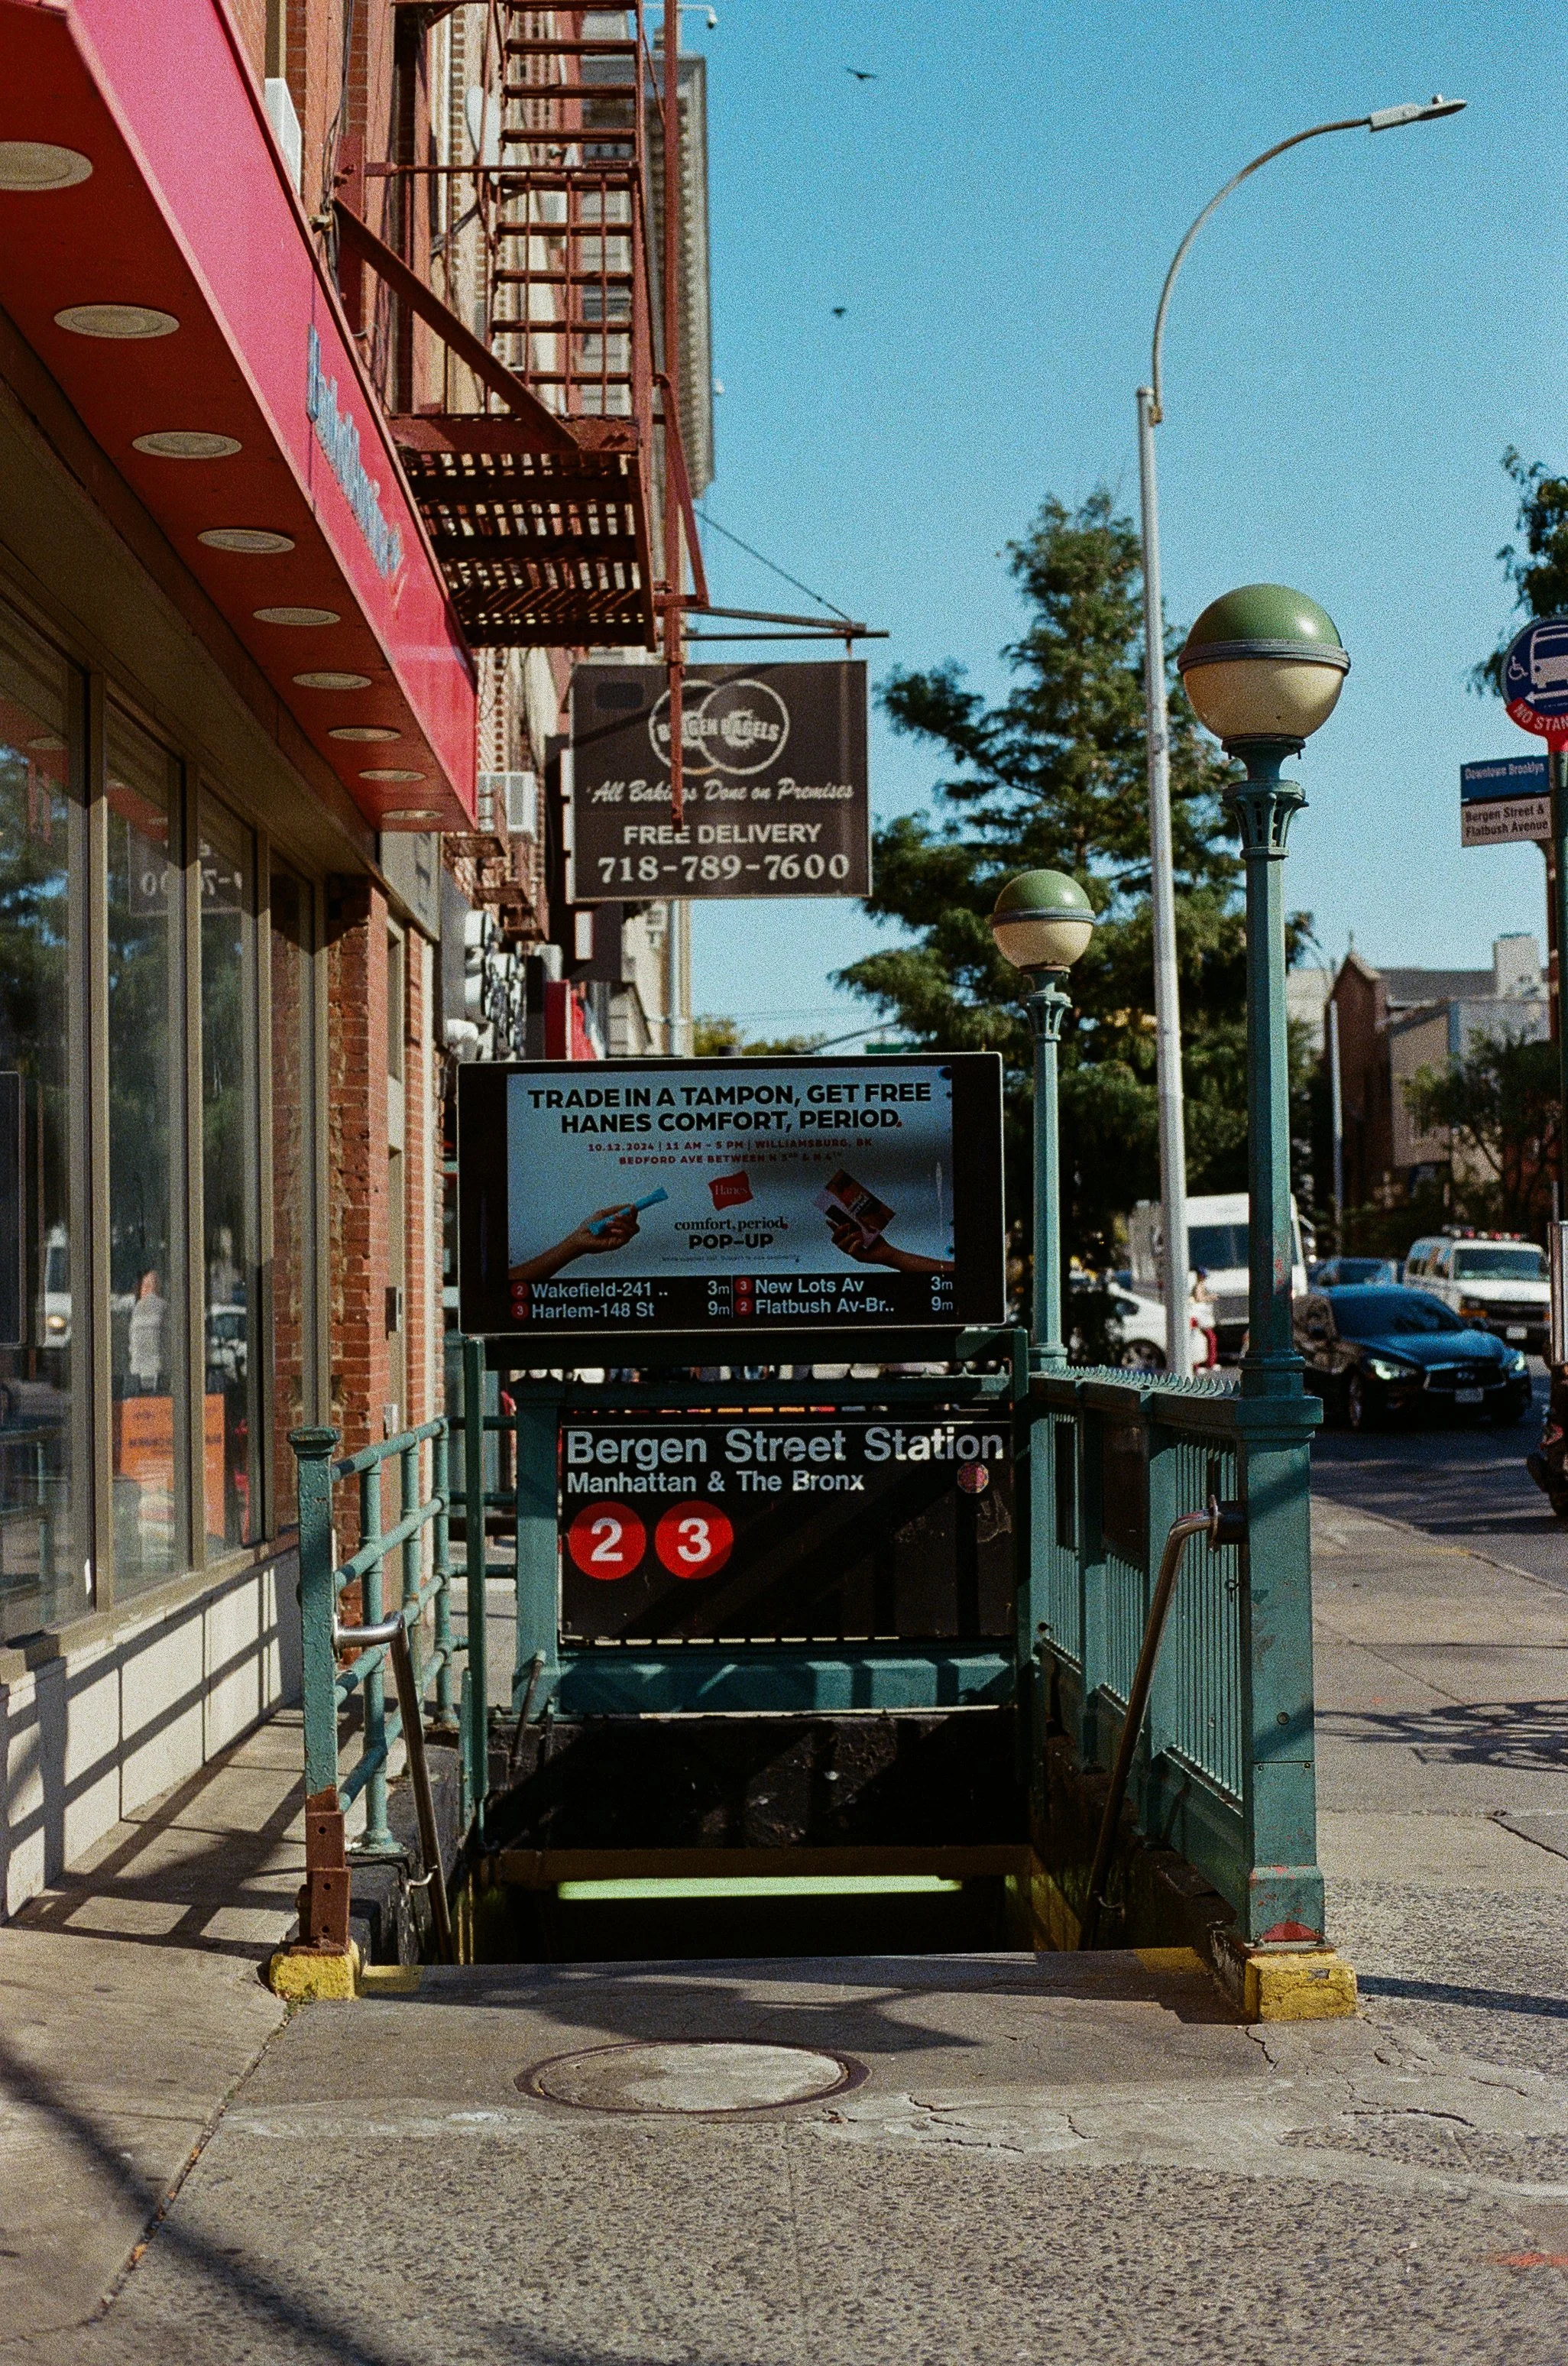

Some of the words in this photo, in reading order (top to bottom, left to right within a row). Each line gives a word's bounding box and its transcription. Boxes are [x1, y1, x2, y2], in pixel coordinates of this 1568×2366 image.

[1514, 703, 1534, 723] NO
[1508, 761, 1545, 776] Brooklyn
[591, 779, 625, 803] All
[703, 778, 747, 801] Done
[751, 786, 772, 801] on
[776, 776, 855, 801] Premises
[1466, 810, 1501, 823] Bergen
[1503, 806, 1534, 818] Street
[624, 825, 691, 845] FREE
[698, 822, 823, 844] DELIVERY
[1466, 824, 1509, 838] Flatbush
[1511, 821, 1549, 833] Avenue
[598, 853, 850, 884] 718-789-7600
[527, 1088, 620, 1109] TRADE
[625, 1087, 651, 1107] IN
[656, 1087, 676, 1107] A
[680, 1085, 801, 1107] TAMPON,
[807, 1084, 860, 1104] GET
[865, 1082, 931, 1103] FREE
[561, 1113, 652, 1133] HANES
[658, 1110, 792, 1133] COMFORT,
[799, 1108, 902, 1130] PERIOD.
[588, 1142, 654, 1152] 10.12.2024
[666, 1141, 680, 1151] 11
[684, 1141, 701, 1150] AM
[715, 1141, 722, 1149] 5
[727, 1139, 743, 1149] PM
[856, 1138, 873, 1147] BK
[619, 1155, 676, 1165] BEDFORD
[680, 1155, 703, 1164] AVE
[707, 1154, 765, 1163] BETWEEN
[769, 1153, 777, 1162] N
[714, 1184, 748, 1195] Hanes
[688, 1233, 774, 1249] POP-UP
[516, 1285, 523, 1295] 2
[531, 1282, 651, 1298] Wakefield-241
[708, 1280, 730, 1295] 3m
[740, 1282, 747, 1291] 3
[755, 1279, 792, 1294] New
[798, 1278, 837, 1293] Lots
[841, 1277, 864, 1292] Av
[931, 1276, 954, 1291] 3m
[517, 1305, 524, 1315] 3
[532, 1302, 630, 1318] Harlem-148
[636, 1301, 655, 1318] St
[708, 1301, 730, 1316] 9m
[740, 1302, 747, 1311] 2
[755, 1298, 831, 1314] Flatbush
[931, 1296, 954, 1311] 9m
[566, 1430, 708, 1470] Bergen
[724, 1428, 847, 1463] Street
[863, 1425, 1004, 1462] Station
[566, 1470, 698, 1494] Manhattan
[708, 1471, 725, 1493] &
[736, 1470, 783, 1493] The
[792, 1469, 865, 1492] Bronx
[590, 1517, 624, 1562] 2
[677, 1517, 711, 1562] 3
